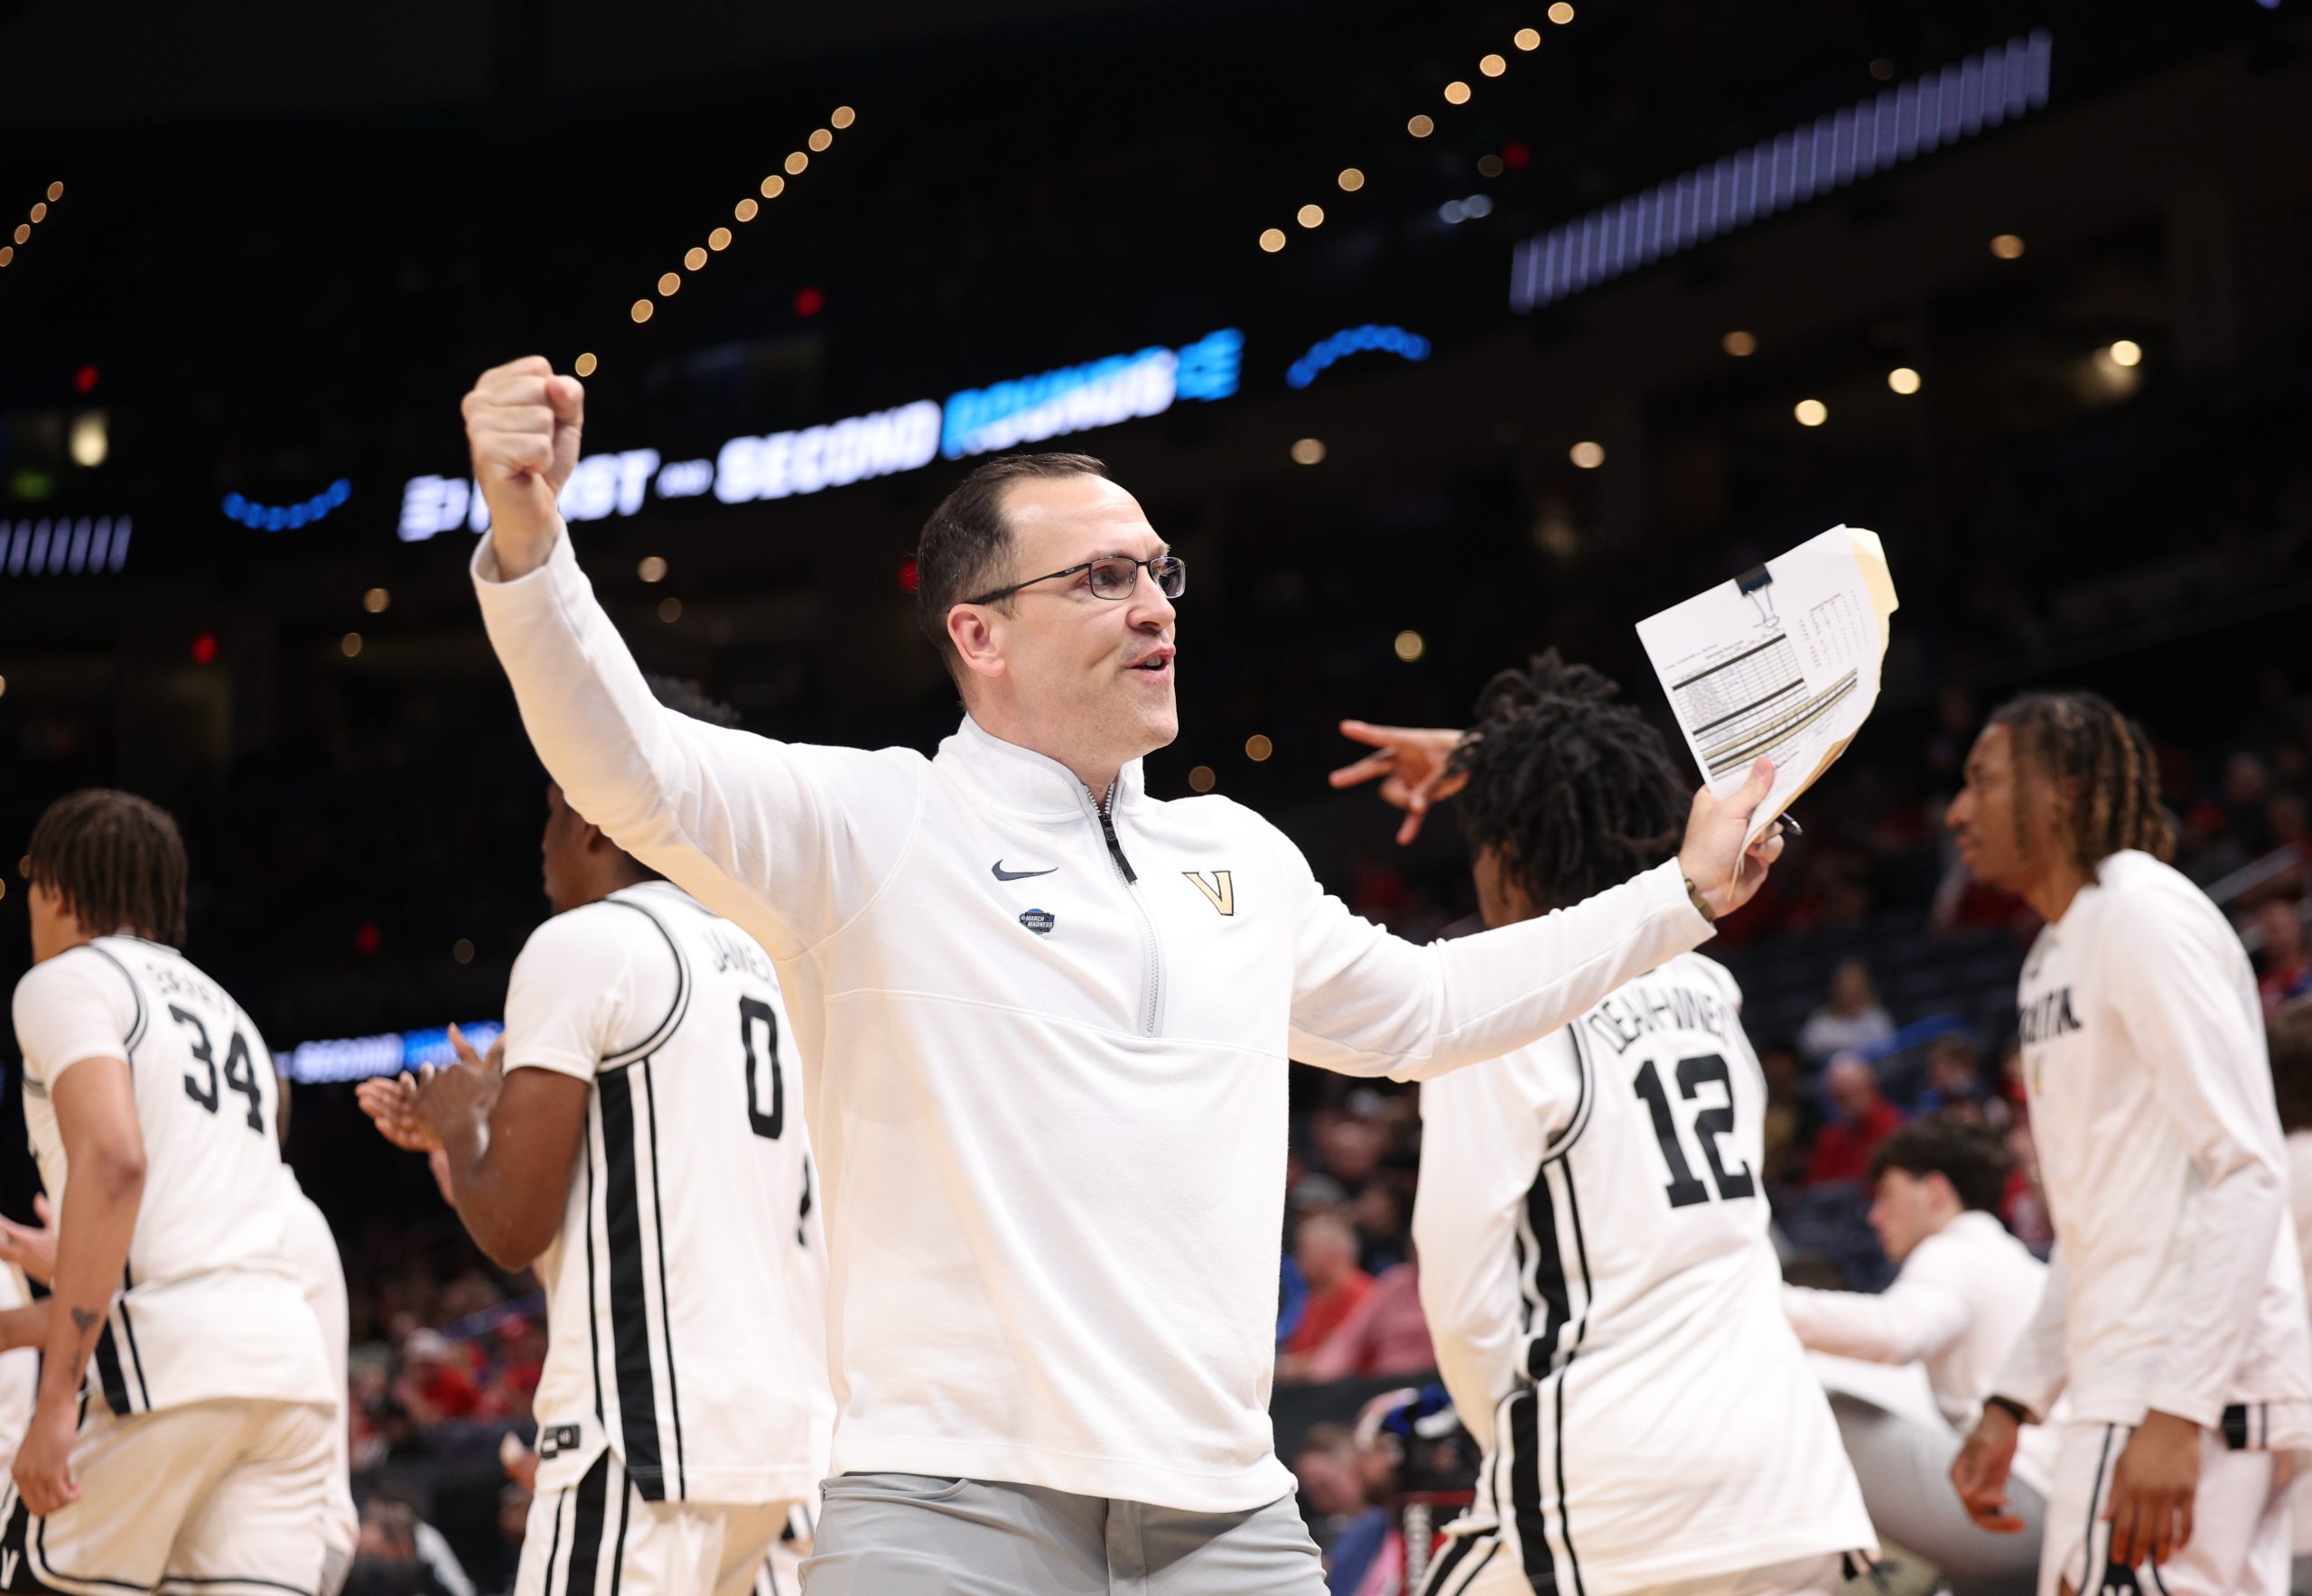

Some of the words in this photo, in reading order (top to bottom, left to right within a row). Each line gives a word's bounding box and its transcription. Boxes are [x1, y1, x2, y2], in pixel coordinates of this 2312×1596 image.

[1181, 870, 1234, 916] V
[168, 1003, 264, 1134] 34
[739, 994, 783, 1140] 0
[1633, 1053, 1756, 1208] 12
